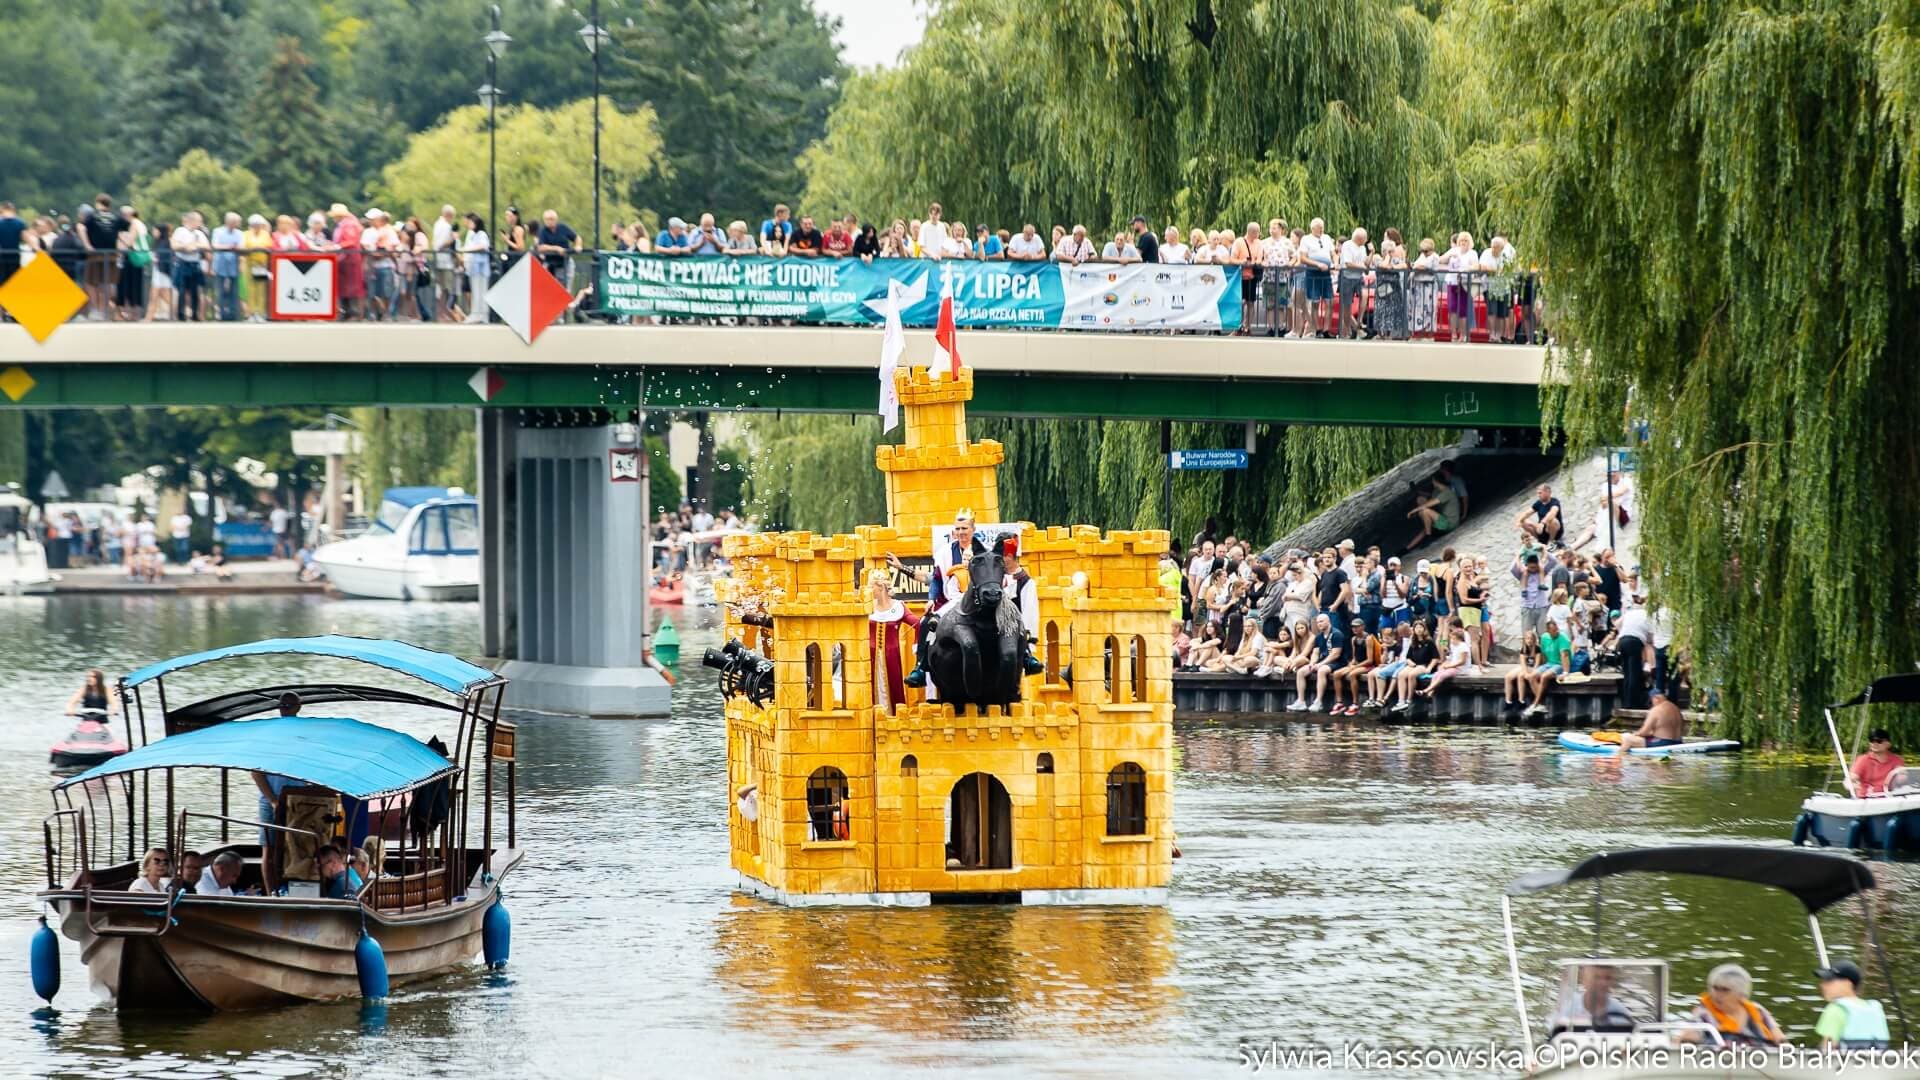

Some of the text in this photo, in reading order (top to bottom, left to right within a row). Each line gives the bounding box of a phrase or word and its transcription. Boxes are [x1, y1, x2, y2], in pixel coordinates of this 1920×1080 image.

[608, 256, 840, 287] CO MA PŁYWAĆ NIE UTONIE
[974, 272, 1042, 299] LIPCA
[701, 287, 733, 301] POLSKI
[735, 289, 746, 301] W
[794, 291, 807, 303] NA
[608, 295, 615, 308] Z
[740, 303, 750, 315] W
[990, 308, 1017, 322] RZEKĄ
[1018, 308, 1045, 322] NETTĄ
[1185, 451, 1207, 459] Bulwar
[1199, 459, 1237, 468] Europejskiej
